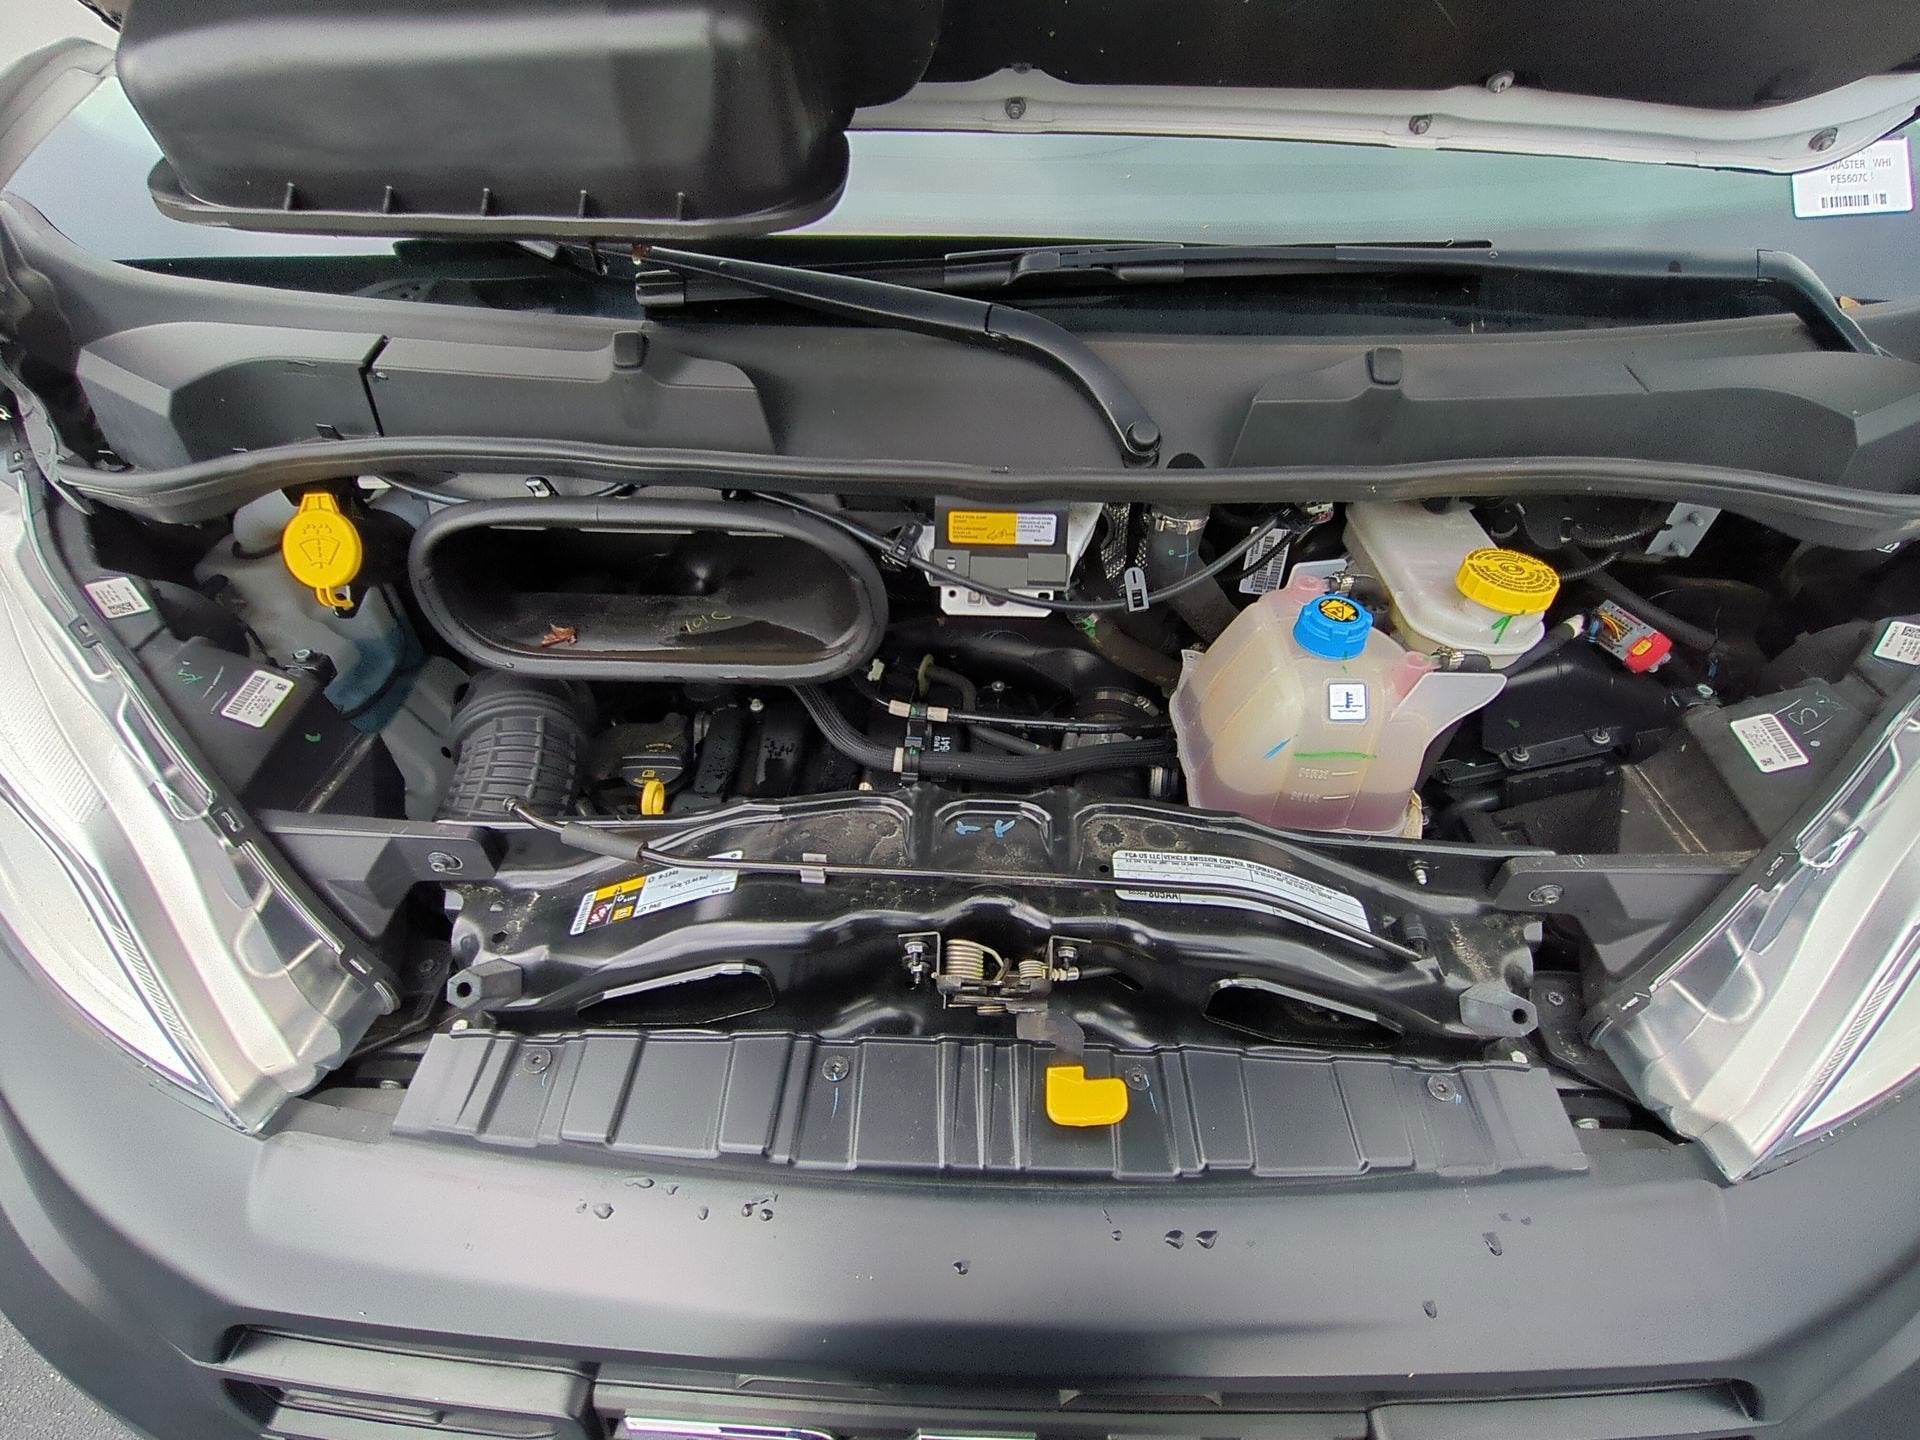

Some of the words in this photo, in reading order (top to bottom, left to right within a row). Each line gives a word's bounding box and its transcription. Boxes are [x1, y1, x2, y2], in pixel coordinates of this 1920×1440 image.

[1189, 855, 1218, 863] EMISSION
[1220, 858, 1246, 868] CONTROL
[1246, 862, 1282, 877] INFORMATION
